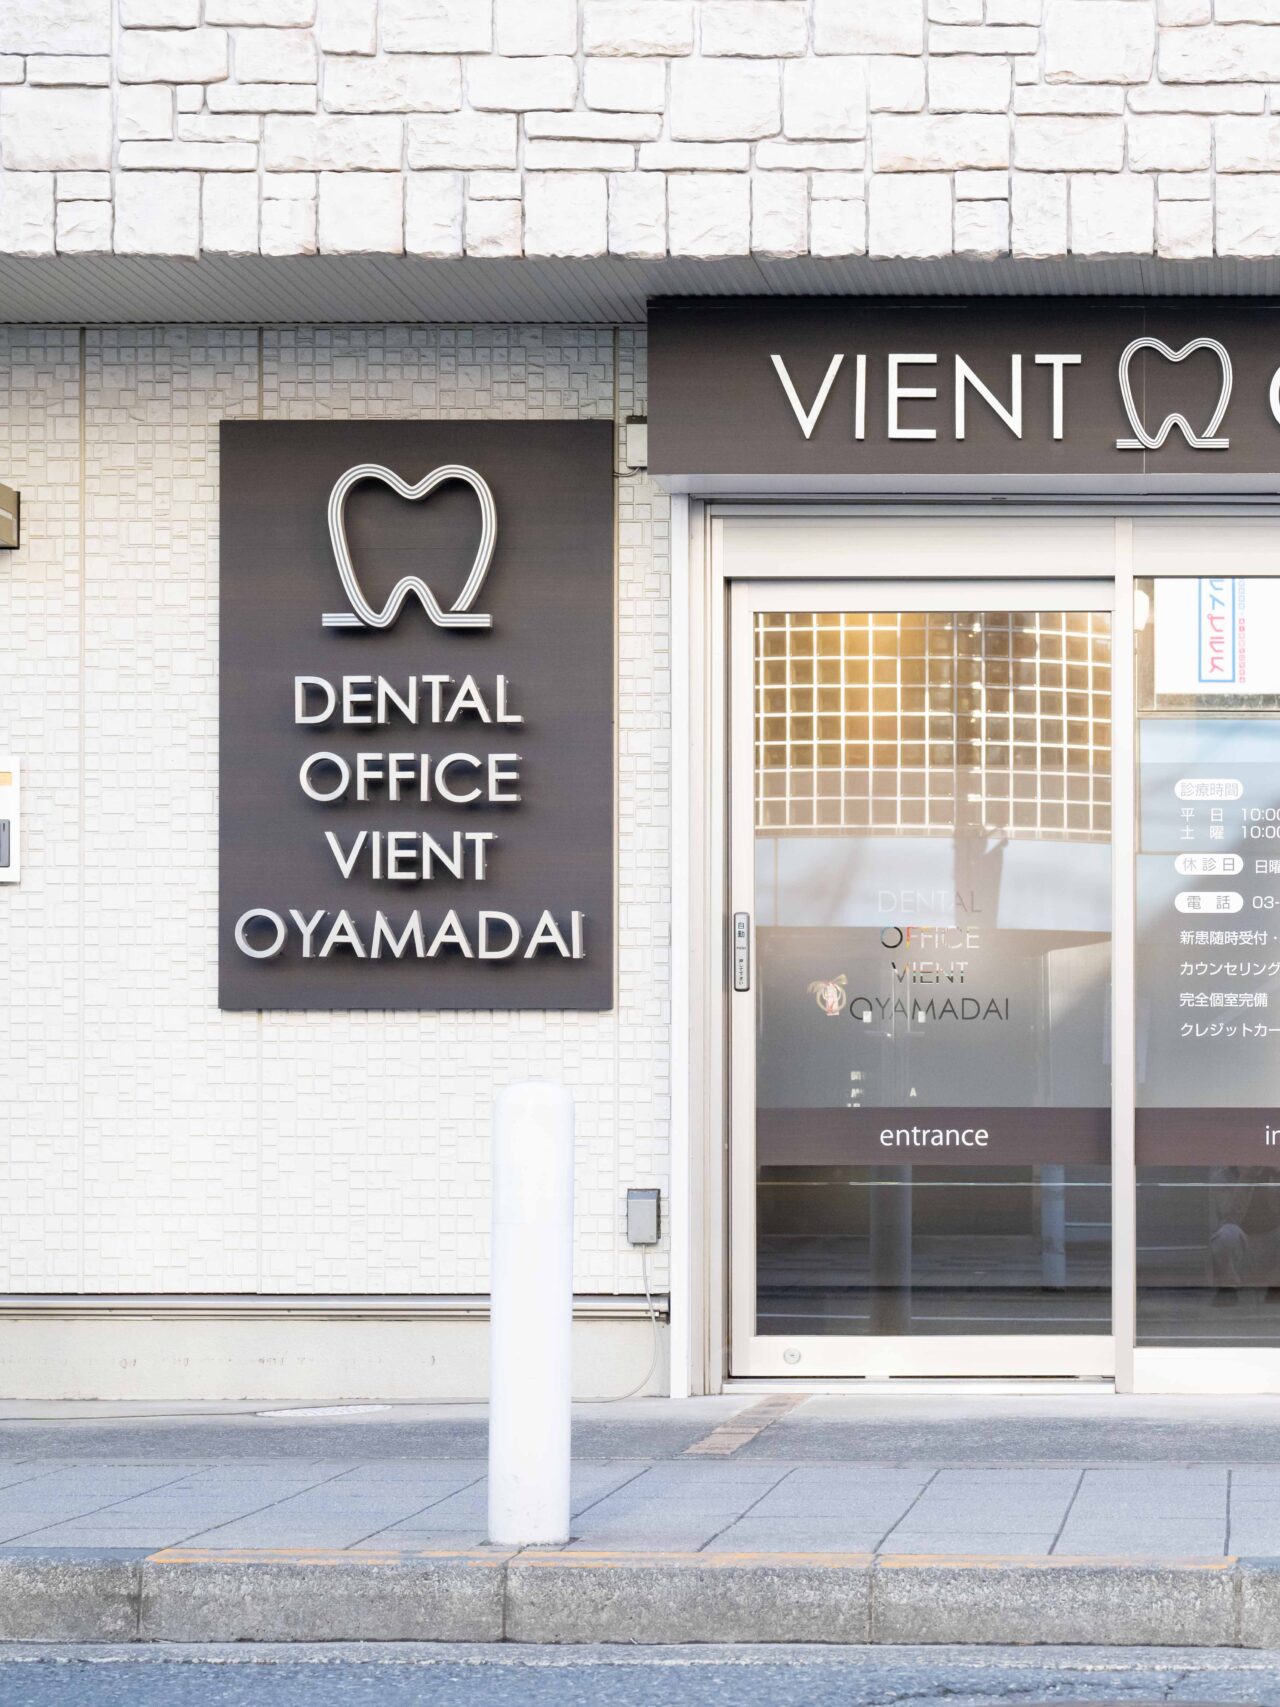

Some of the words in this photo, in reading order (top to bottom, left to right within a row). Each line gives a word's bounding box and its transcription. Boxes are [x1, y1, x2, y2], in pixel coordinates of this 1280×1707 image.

[770, 353, 1082, 440] VIENT
[294, 674, 524, 726] DENTAL
[298, 751, 523, 803] OFFICE
[1180, 782, 1239, 797] 診療時間
[324, 830, 498, 881] VIENT
[1181, 857, 1236, 872] 休診日
[878, 890, 982, 913] DENTAL
[234, 907, 586, 960] OYAMADAI
[737, 922, 746, 938] 自動
[880, 926, 981, 949] OFFICE
[891, 961, 969, 984] VIENT
[849, 996, 1010, 1021] OYAMADAI
[1179, 992, 1268, 1008] 完全個室完備
[879, 1125, 990, 1147] entrance
